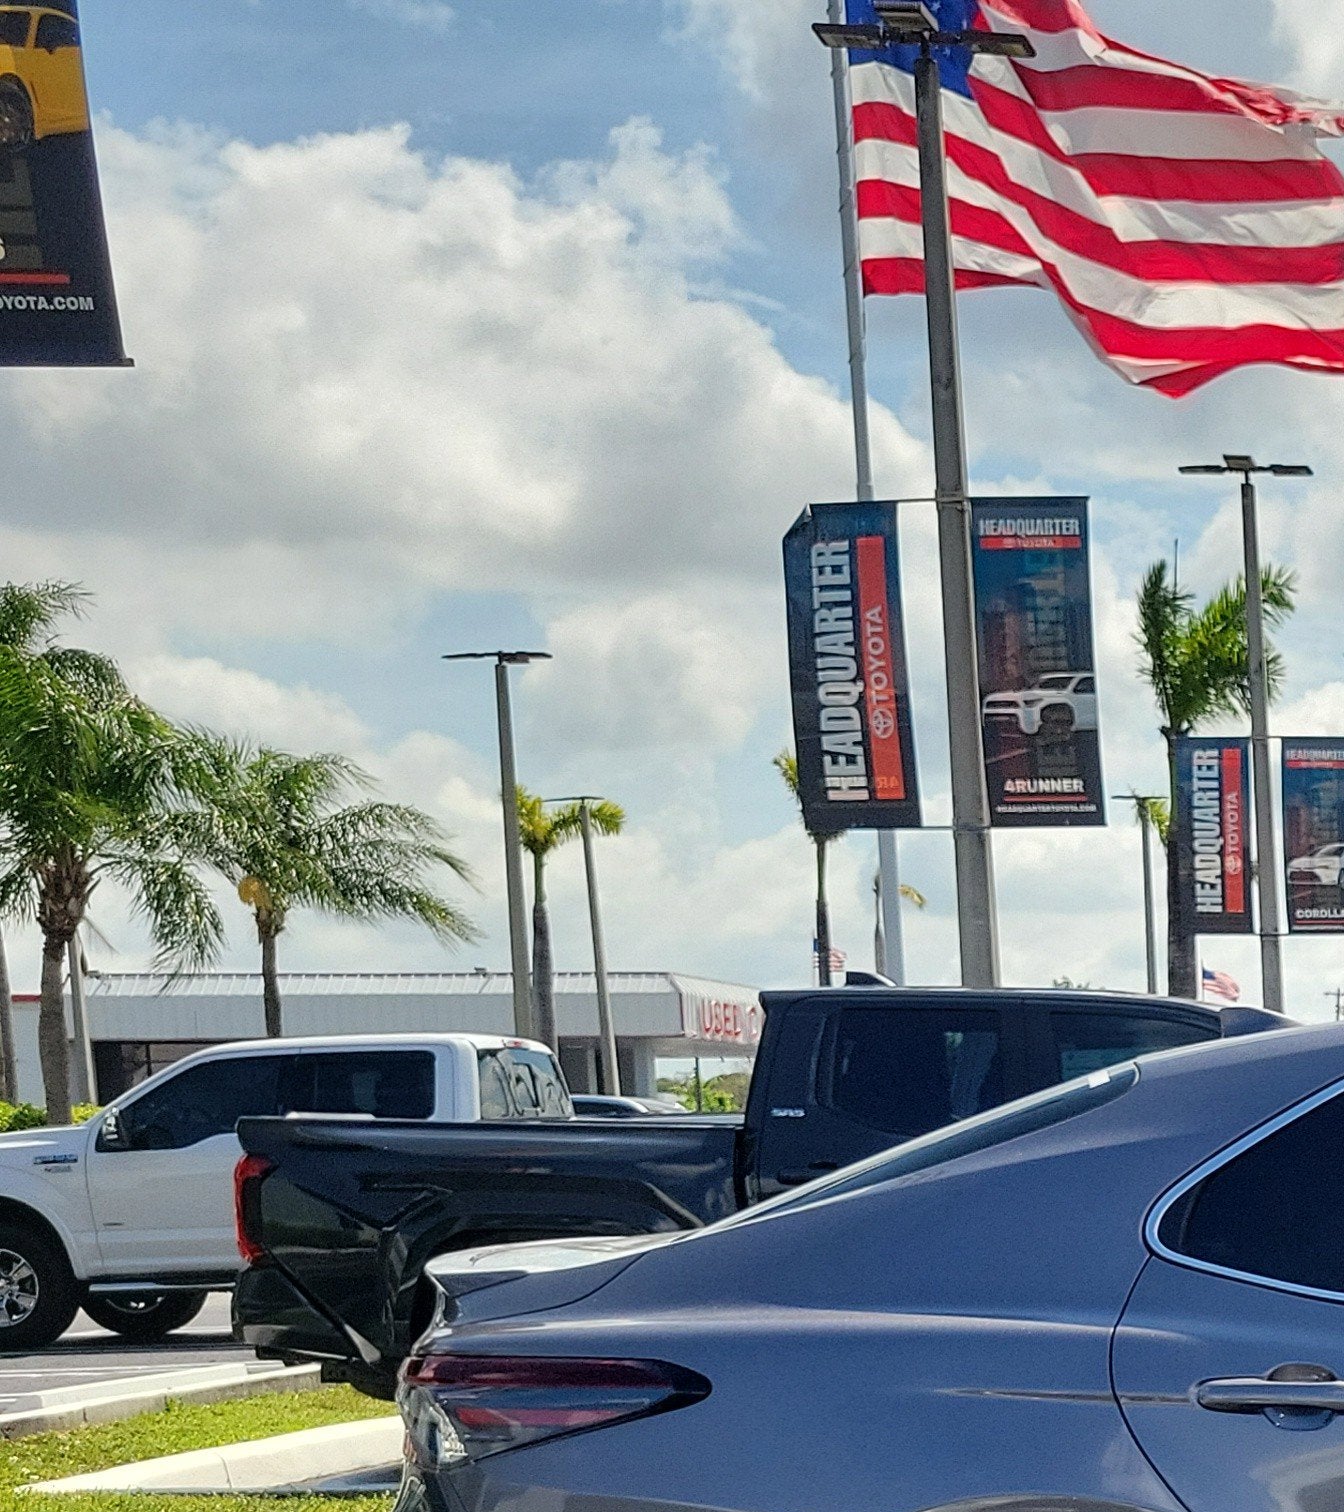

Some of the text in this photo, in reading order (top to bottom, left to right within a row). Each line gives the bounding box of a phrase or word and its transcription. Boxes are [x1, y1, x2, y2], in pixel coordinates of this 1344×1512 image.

[979, 518, 1080, 537] HEADQUARTER
[811, 538, 870, 801] HEADQUARTER
[864, 604, 894, 706] TOYOTA
[1004, 778, 1085, 793] 4RUNNER
[1192, 748, 1223, 913] HEADQUARTER
[1225, 792, 1240, 858] TOYOTA
[702, 1000, 742, 1036] USED
